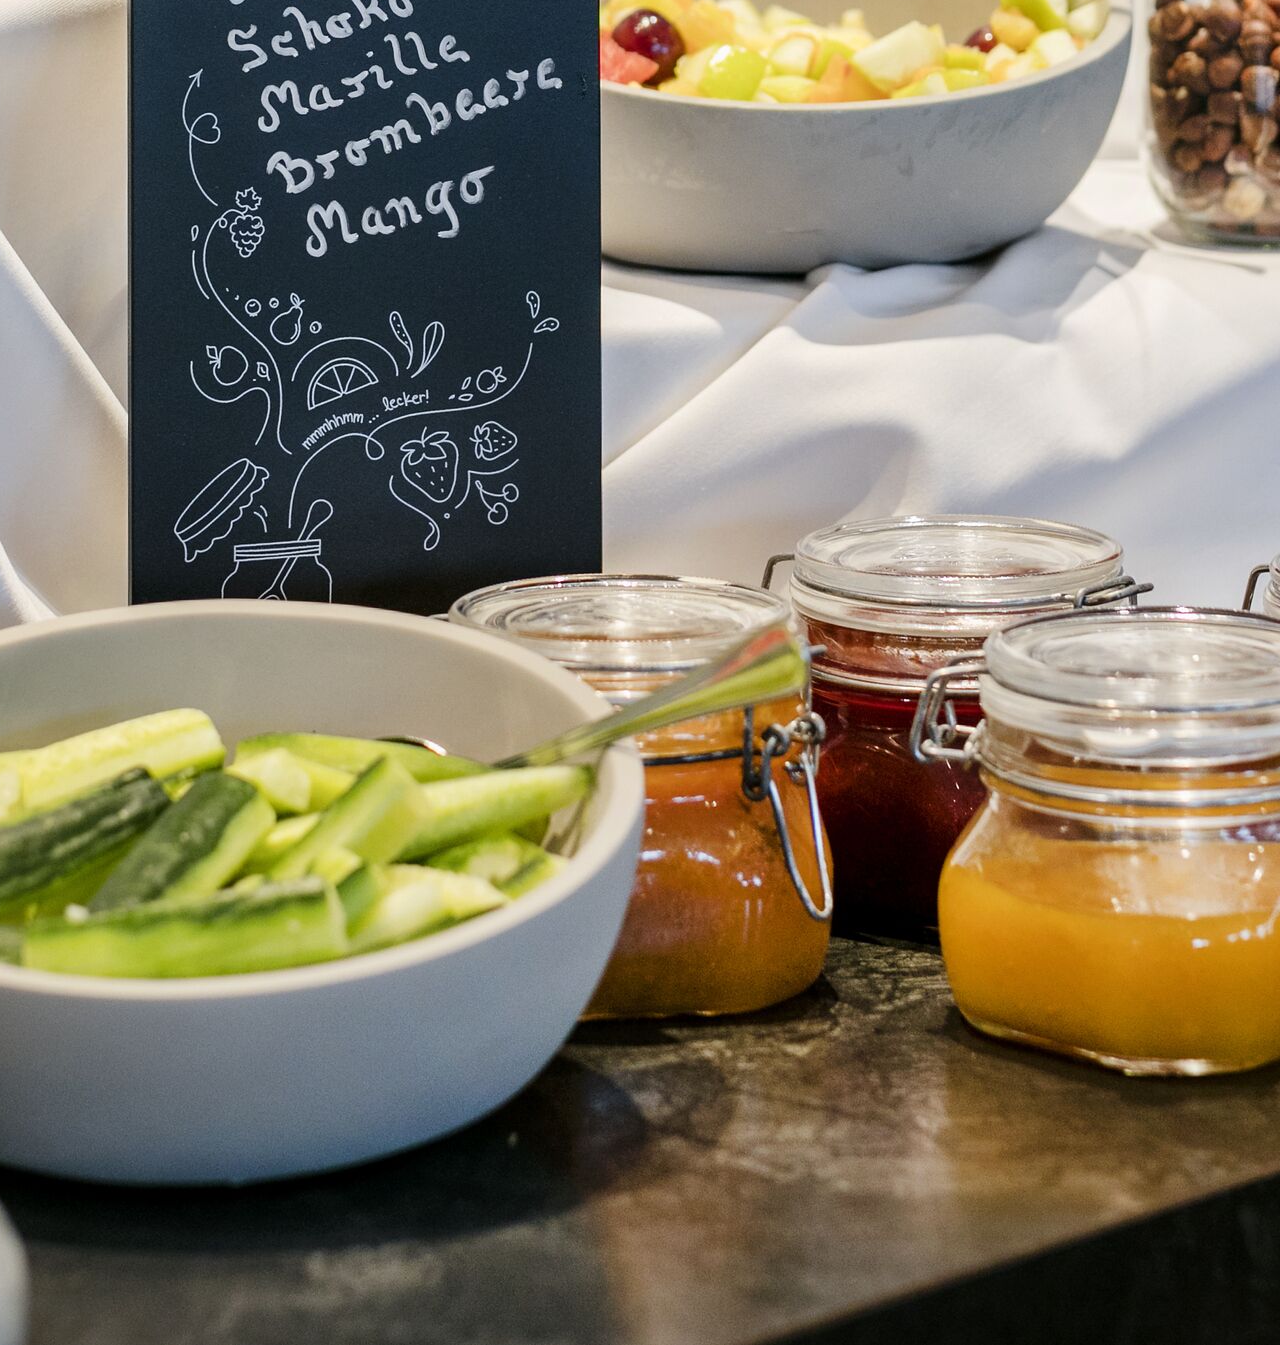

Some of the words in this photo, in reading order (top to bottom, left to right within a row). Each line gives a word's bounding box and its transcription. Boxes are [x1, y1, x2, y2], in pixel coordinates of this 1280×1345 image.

[257, 31, 471, 133] Marille
[266, 57, 563, 194] Brombeere
[306, 165, 496, 258] Mango
[382, 389, 430, 412] lecker!
